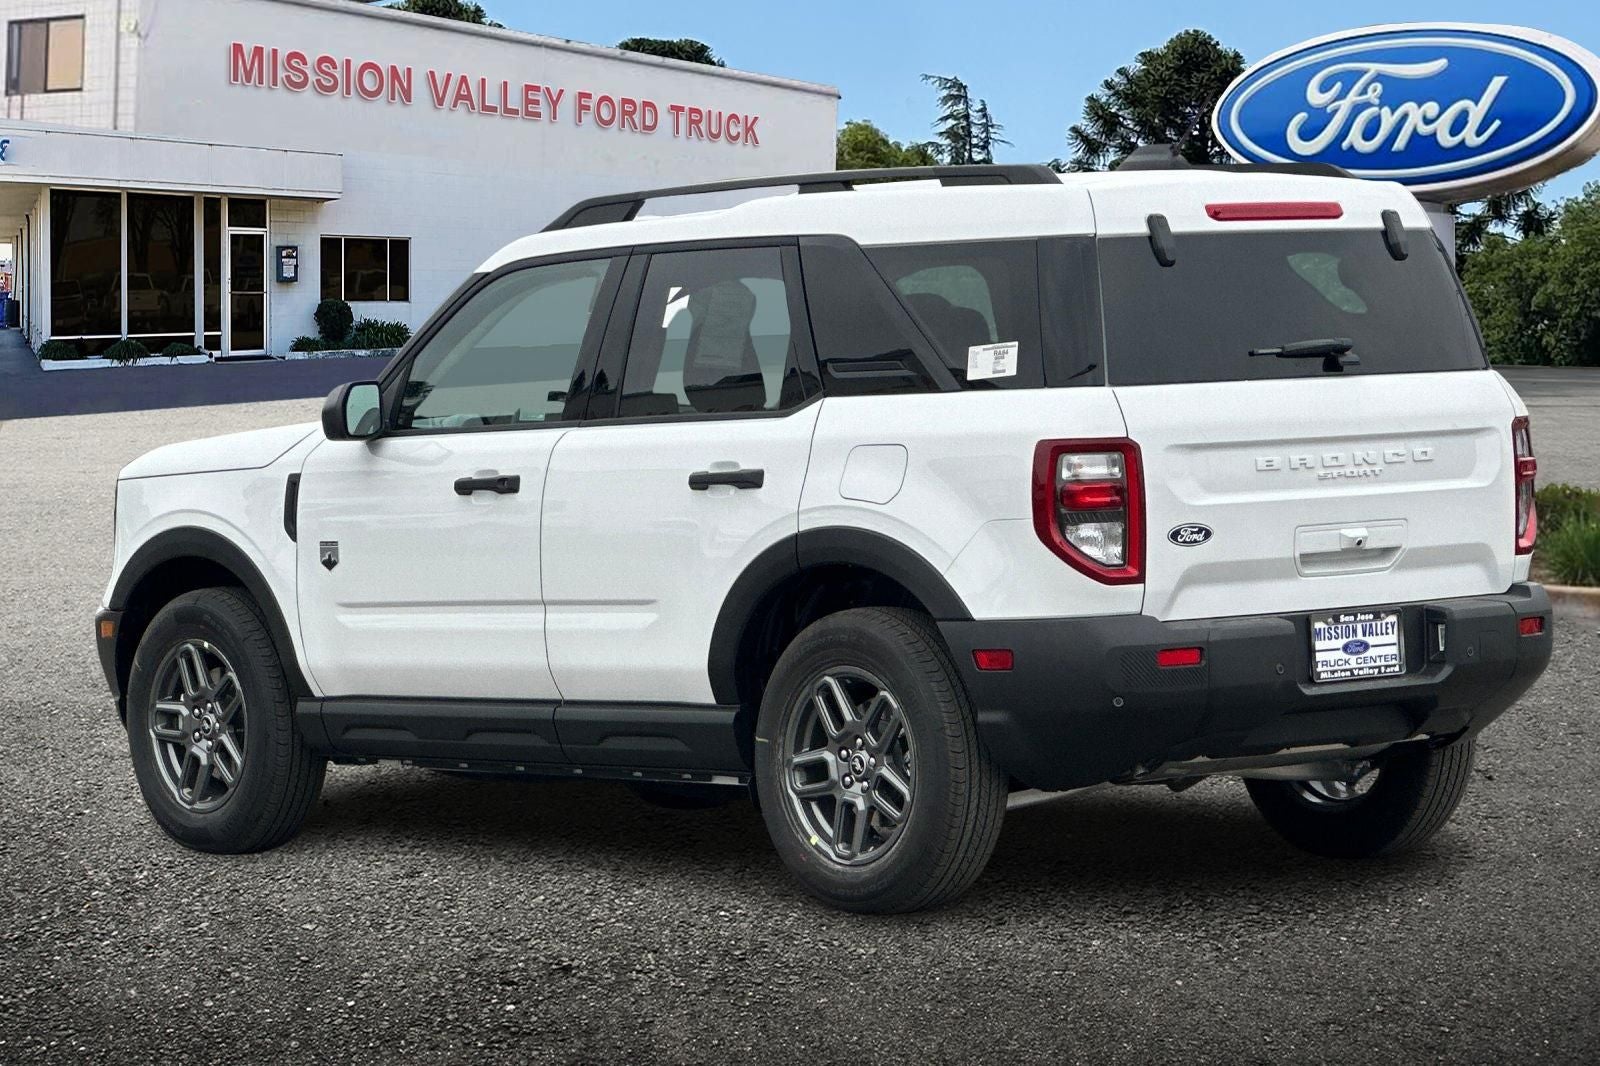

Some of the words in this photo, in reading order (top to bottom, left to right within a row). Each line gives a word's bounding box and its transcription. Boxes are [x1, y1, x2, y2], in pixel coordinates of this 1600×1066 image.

[230, 41, 414, 104] MISSION
[428, 68, 565, 122] VALLEY
[575, 89, 660, 134] FORD
[669, 103, 760, 146] TRUCK
[1286, 57, 1509, 156] Ford
[1255, 447, 1434, 471] BRONCO
[1317, 467, 1384, 480] SPORT
[1176, 527, 1205, 543] Ford
[1339, 614, 1355, 622] San
[1356, 613, 1374, 621] Jose
[1314, 624, 1358, 641] MISSION
[1361, 621, 1396, 637] VALLEY
[1316, 658, 1351, 669] TRUCK
[1356, 653, 1398, 665] CENTER
[1352, 667, 1379, 676] Valley
